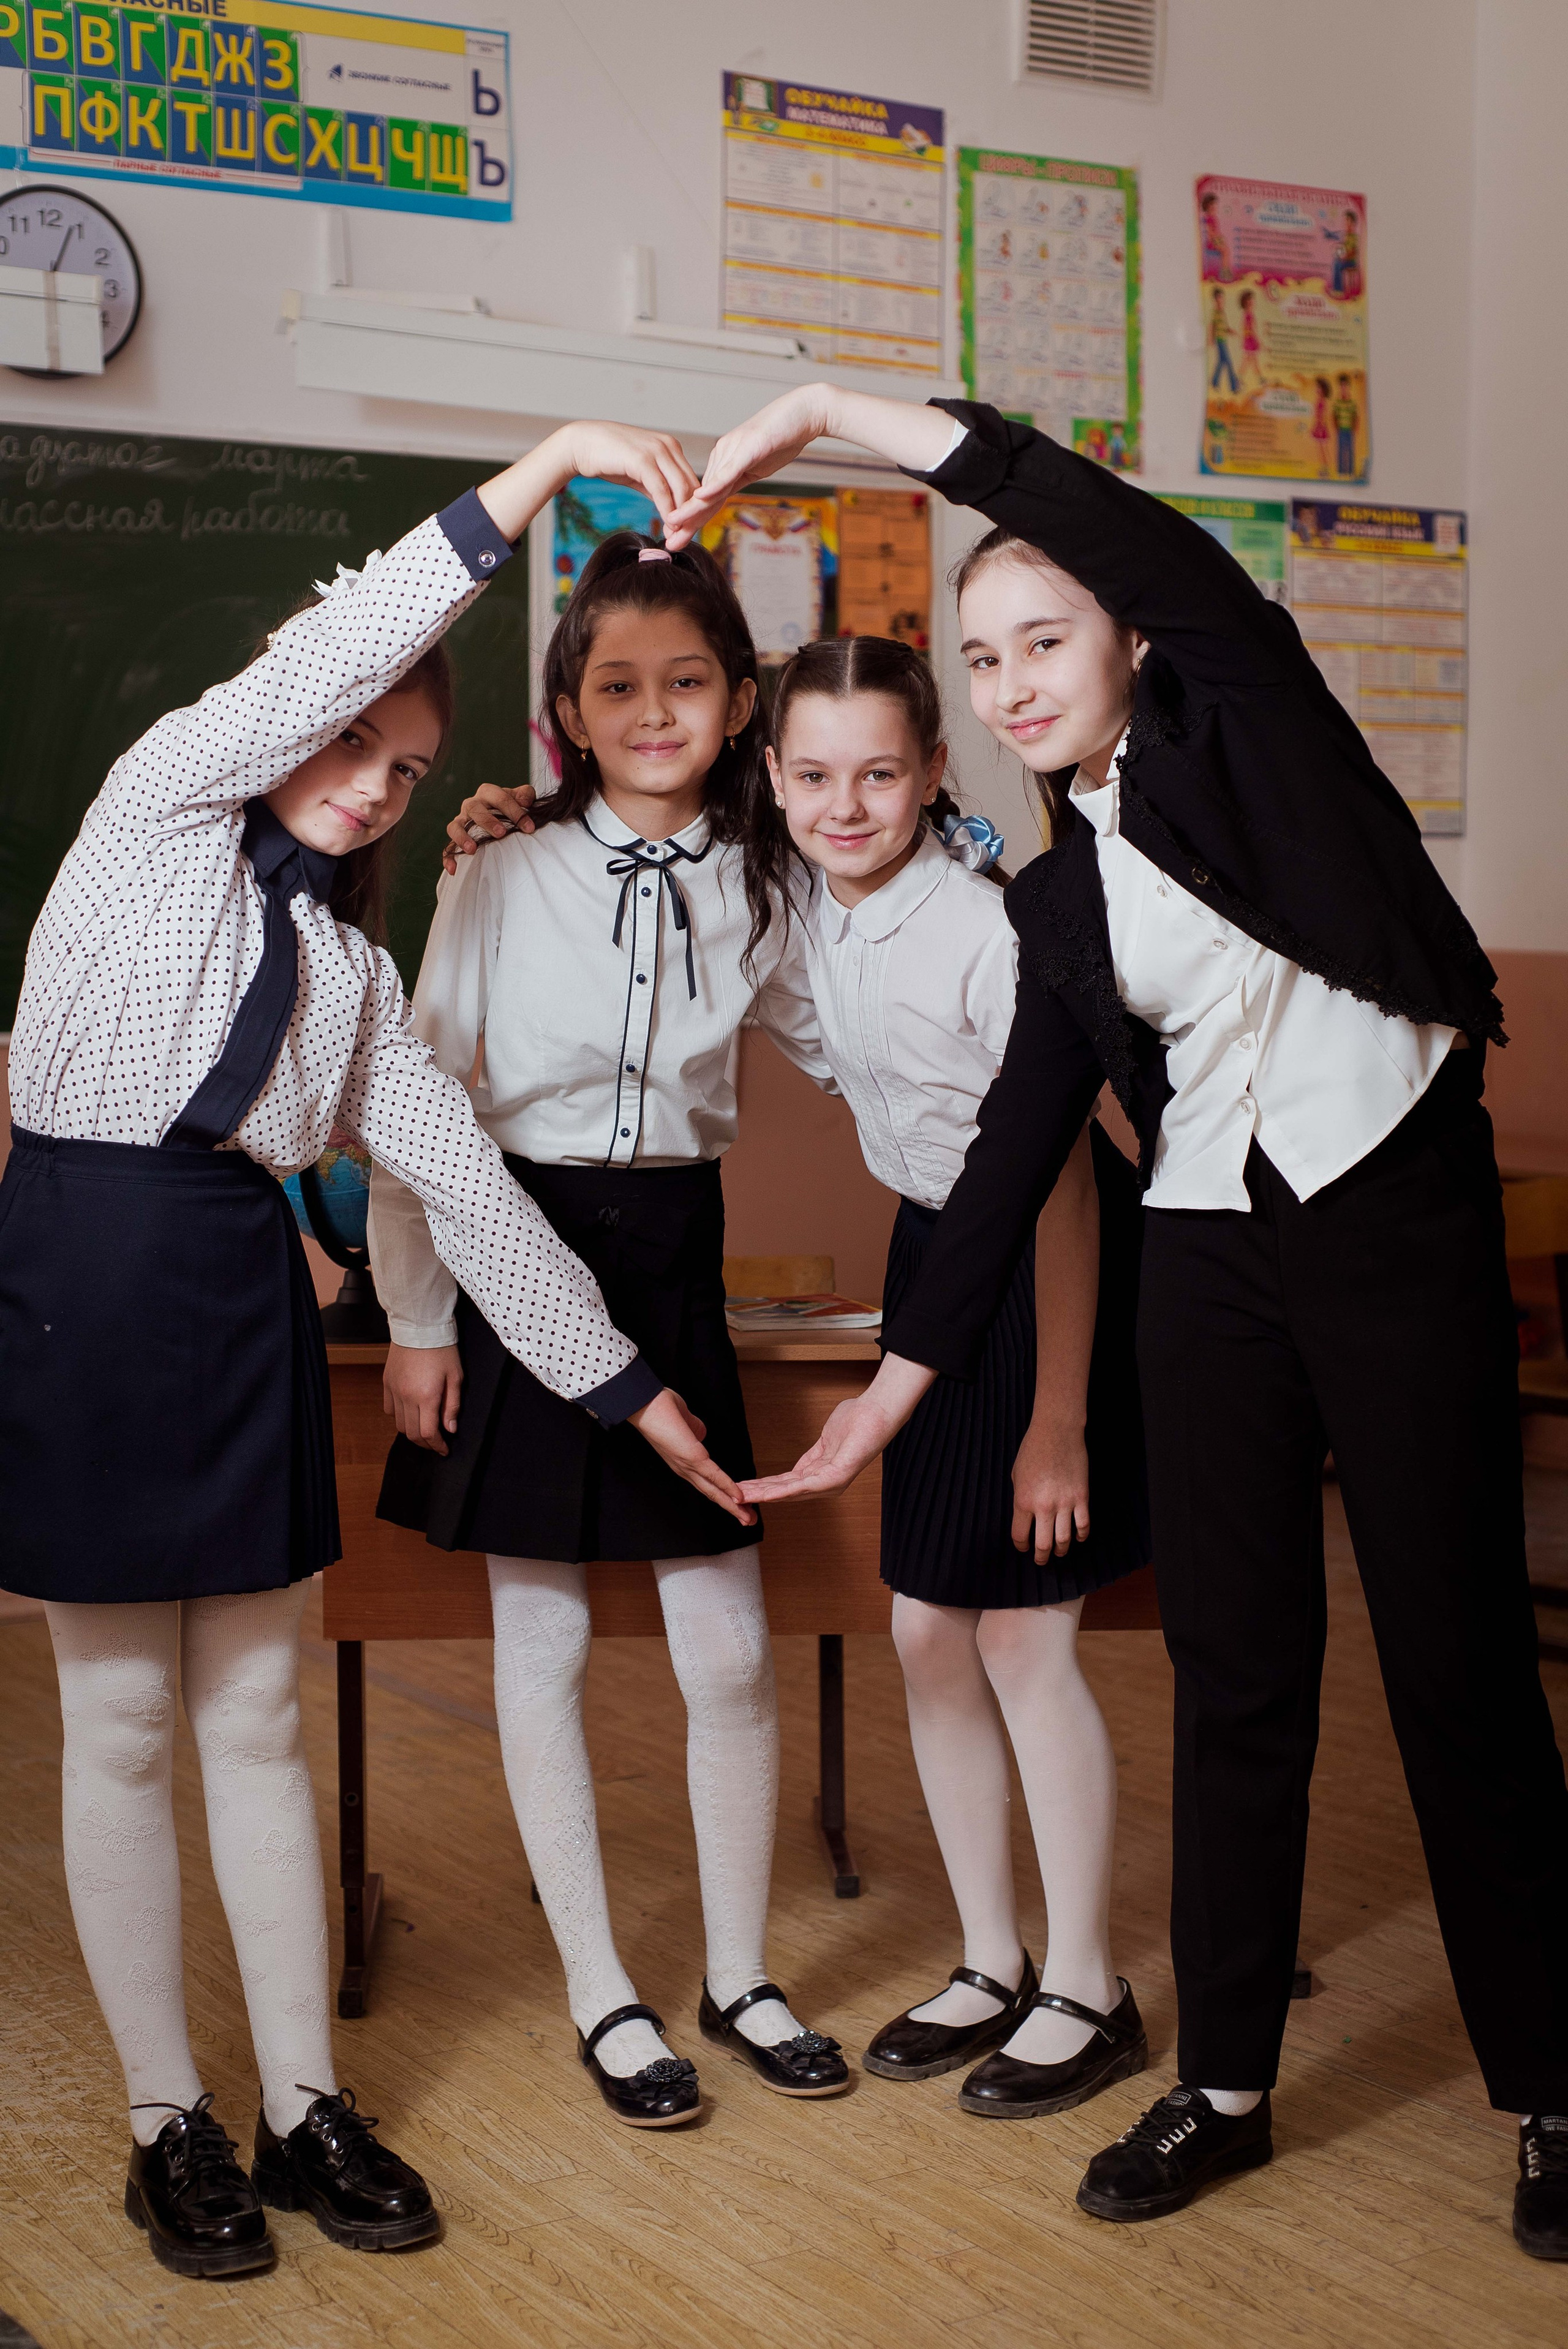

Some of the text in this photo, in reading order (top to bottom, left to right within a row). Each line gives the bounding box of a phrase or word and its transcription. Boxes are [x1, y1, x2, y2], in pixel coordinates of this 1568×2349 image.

[32, 9, 68, 60] Б
[80, 15, 115, 67] В
[129, 21, 157, 71] Г
[171, 27, 211, 86] Д
[213, 32, 256, 86] Ж
[263, 39, 294, 91] З
[472, 67, 501, 116] Ь
[34, 84, 469, 192] П Ф К Т Ш С Х Ц Ч Щ
[471, 138, 506, 187] Ъ
[8, 214, 29, 234] 11
[37, 208, 62, 228] 12
[76, 221, 85, 239] 1
[94, 247, 111, 266] 2
[104, 278, 119, 299] 3
